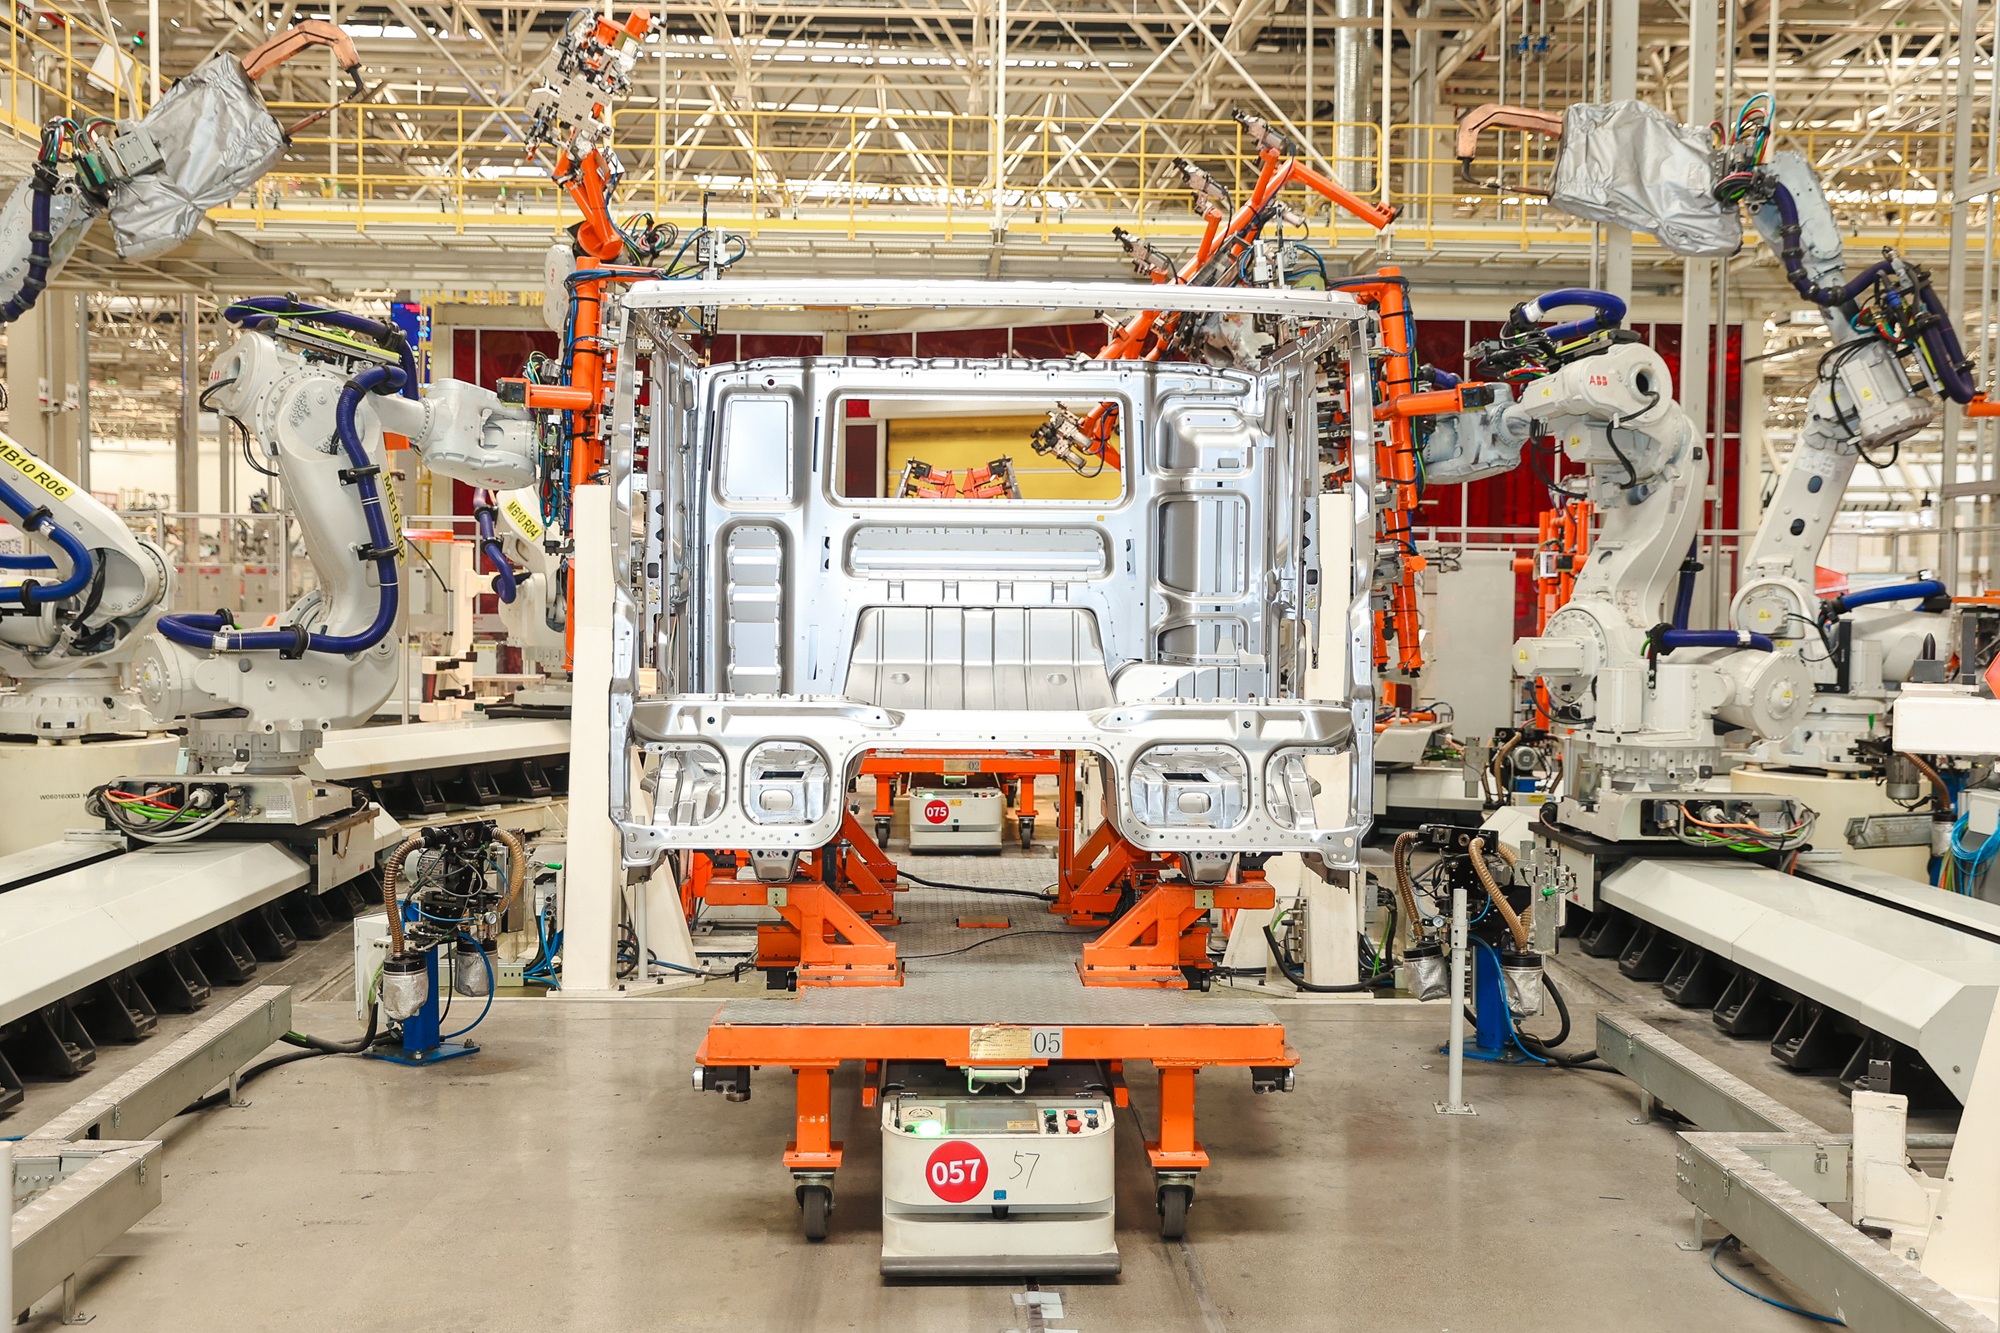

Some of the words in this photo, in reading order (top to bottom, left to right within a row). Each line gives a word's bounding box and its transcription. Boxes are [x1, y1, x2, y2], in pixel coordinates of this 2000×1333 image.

[1589, 374, 1608, 386] ABB
[34, 471, 68, 496] R06
[384, 475, 400, 523] MB10
[507, 501, 527, 523] MB10
[522, 519, 539, 538] R04
[968, 761, 980, 770] 02
[926, 807, 947, 817] 075
[1034, 1032, 1060, 1053] 05
[931, 1158, 981, 1185] 057
[1009, 1150, 1040, 1189] 57
